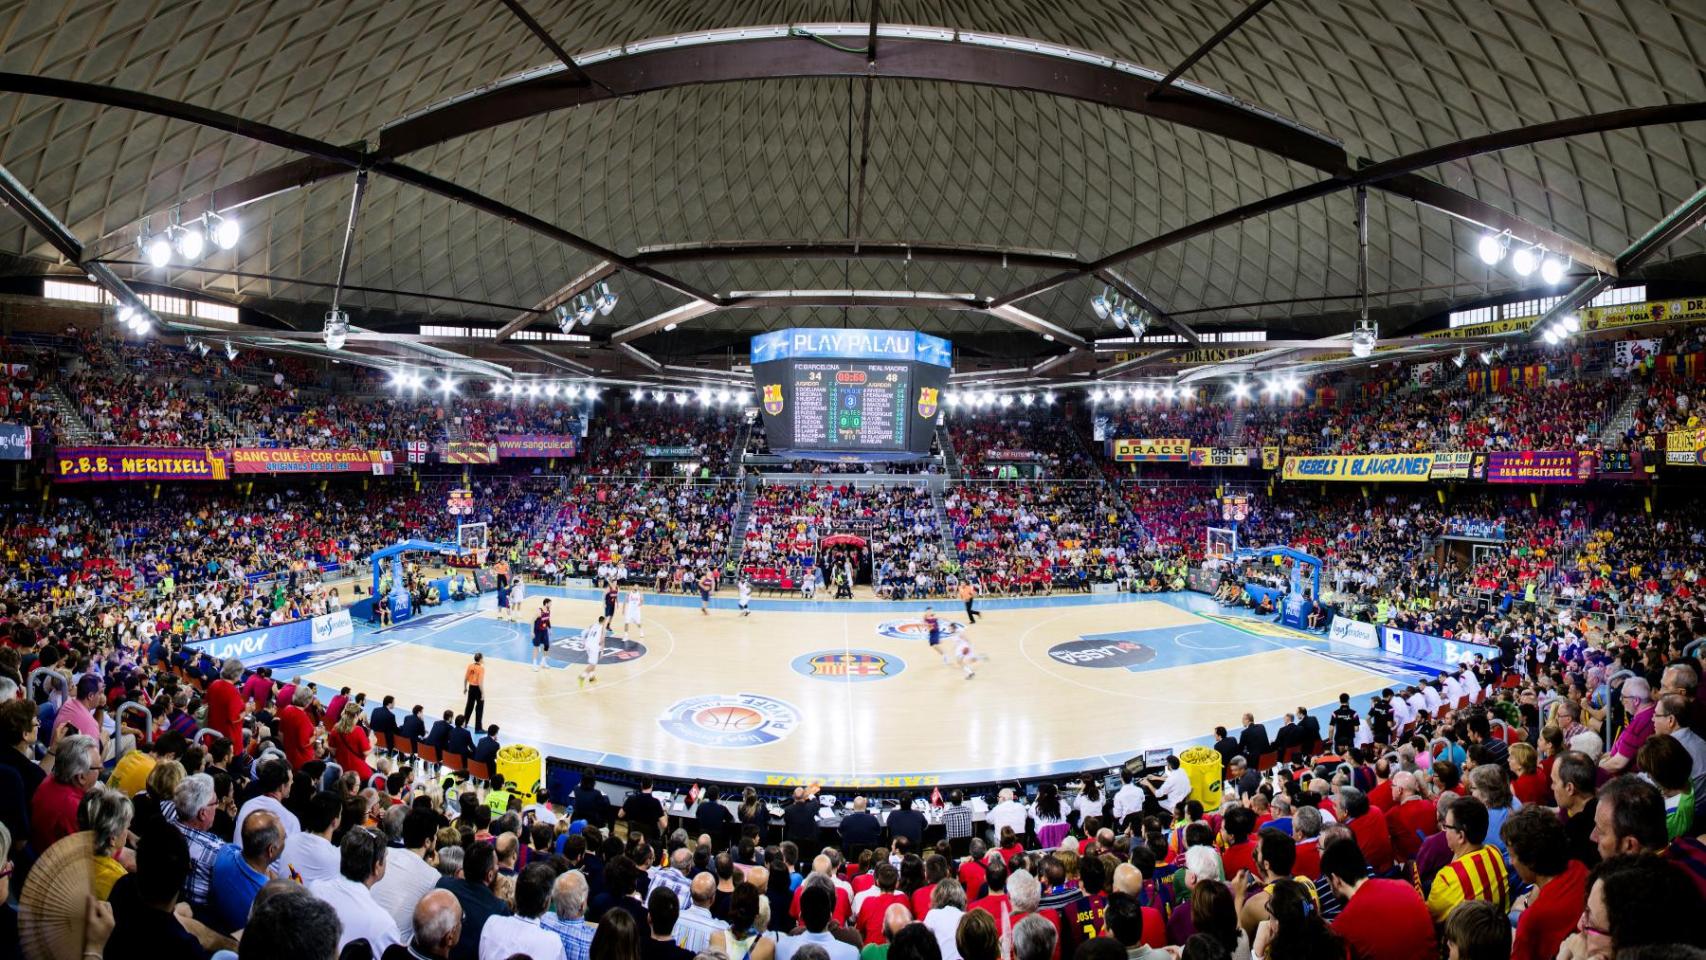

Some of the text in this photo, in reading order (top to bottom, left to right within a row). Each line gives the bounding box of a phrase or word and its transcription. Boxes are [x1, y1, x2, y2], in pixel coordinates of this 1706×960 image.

[1688, 300, 1706, 311] DR
[794, 334, 842, 351] PLAY
[850, 335, 908, 353] PALAU
[809, 372, 822, 380] 34
[886, 373, 898, 382] 48
[234, 451, 269, 462] SANG
[272, 450, 301, 462] CULÉ
[311, 452, 333, 462] COR
[122, 458, 208, 474] MERITXELL
[1298, 458, 1430, 475] REBELS I BLAUGRANES
[1518, 468, 1572, 476] MERITXELL
[210, 633, 268, 659] Lover
[766, 775, 940, 787] BARCELONA
[1076, 910, 1094, 923] JOSE
